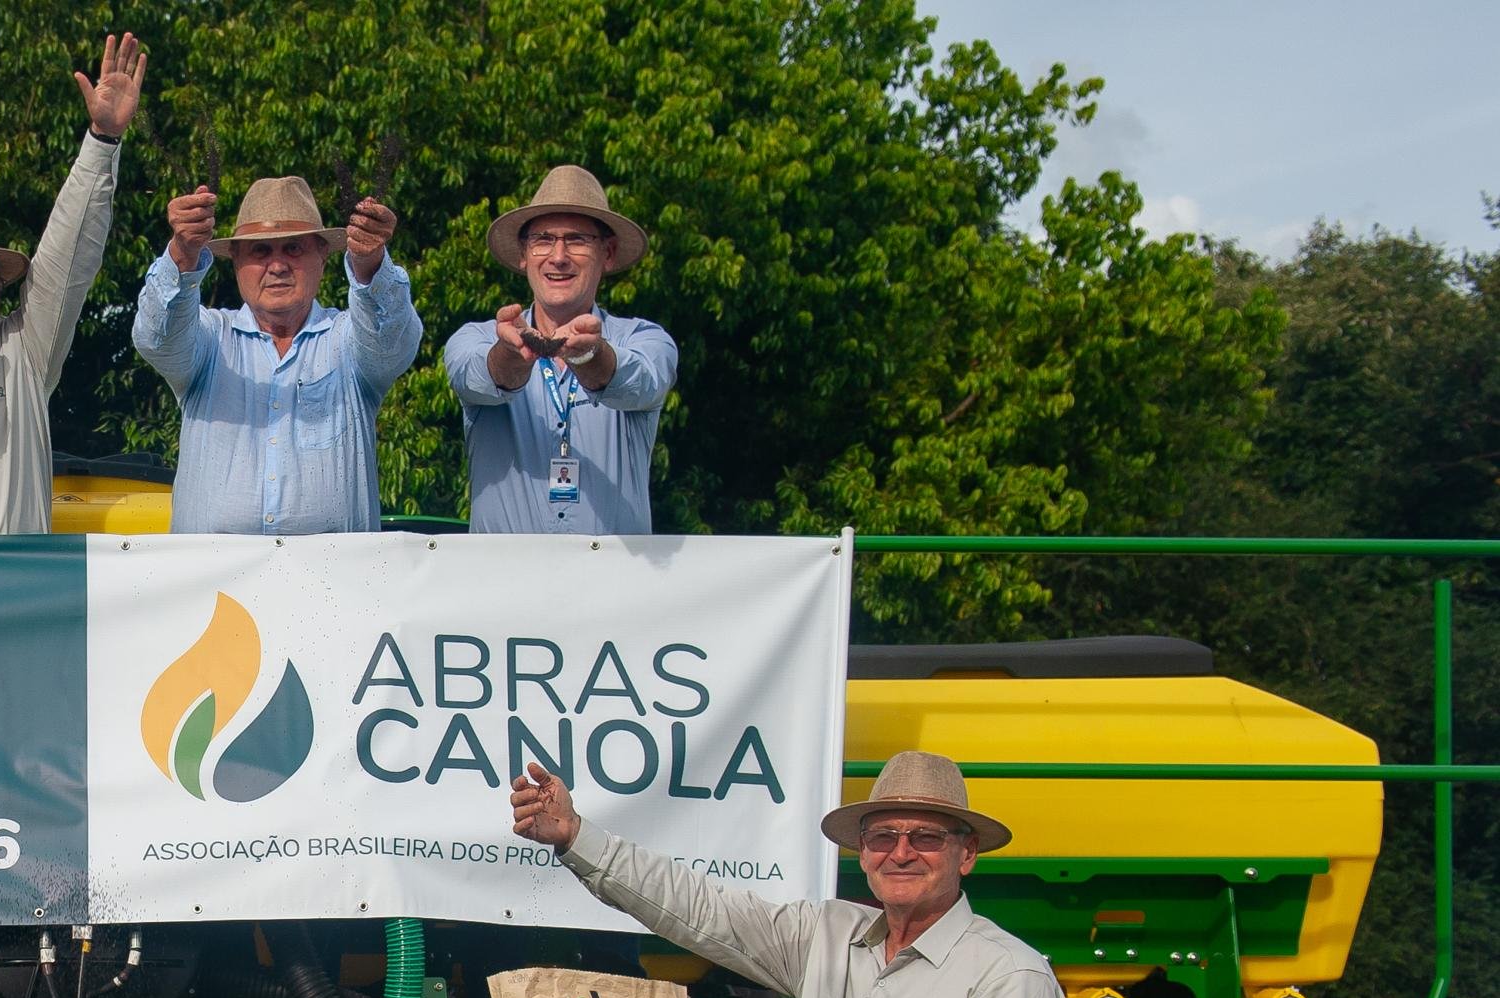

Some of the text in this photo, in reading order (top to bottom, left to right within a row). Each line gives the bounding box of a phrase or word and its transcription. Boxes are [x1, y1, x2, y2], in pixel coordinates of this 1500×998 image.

[352, 632, 710, 718] ABRAS
[356, 708, 786, 804] CANOLA
[143, 835, 300, 862] ASSOCIAÇÃO
[308, 836, 444, 860] BRASILEIRA
[451, 842, 500, 864] DOS
